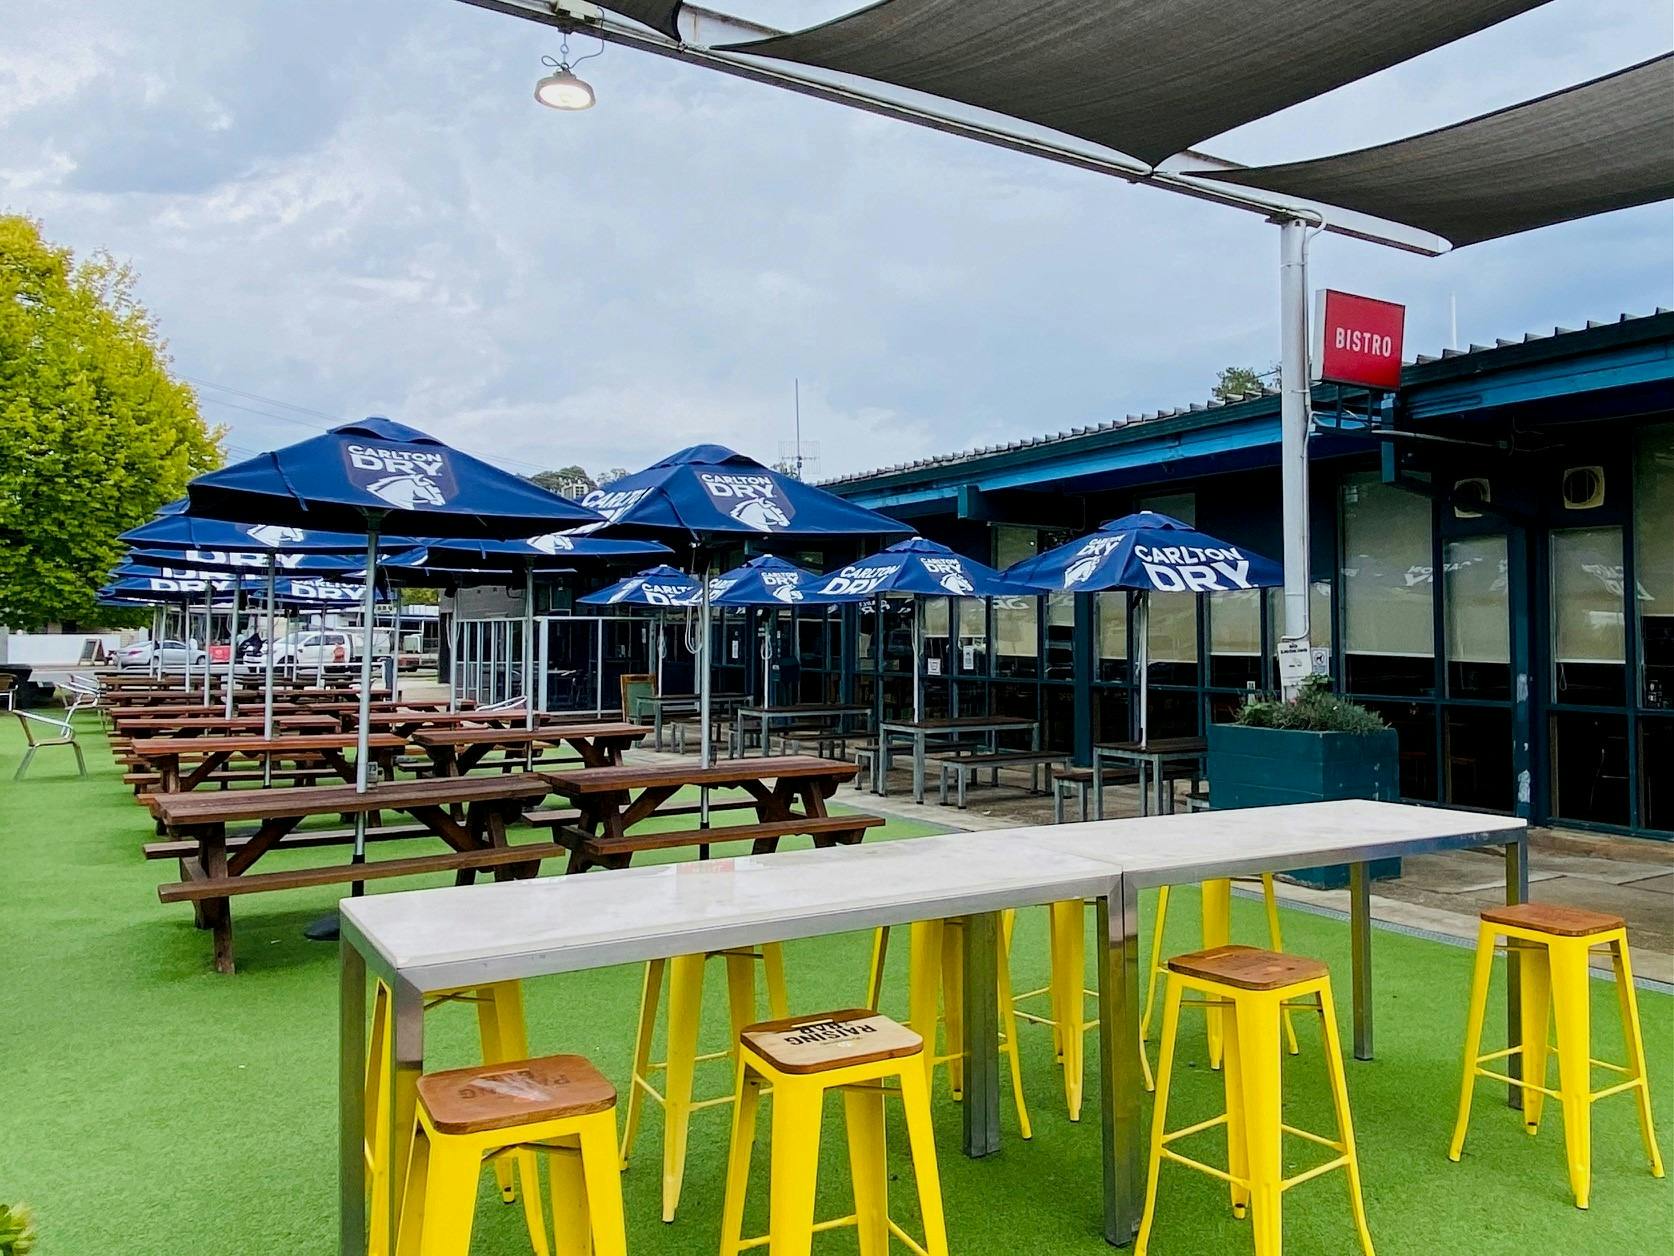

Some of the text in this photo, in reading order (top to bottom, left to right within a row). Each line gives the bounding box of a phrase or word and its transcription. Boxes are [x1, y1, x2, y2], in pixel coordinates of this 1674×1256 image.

[1335, 327, 1391, 358] BISTRO
[347, 445, 442, 462] CARLTON
[350, 453, 443, 477] DRY
[701, 473, 770, 485] CARLTON
[705, 482, 775, 498] DRY
[1076, 540, 1120, 556] DRY
[1134, 545, 1244, 565] CARLTON
[840, 564, 900, 579] CARLTON
[924, 562, 962, 574] DRY
[1142, 560, 1255, 592] DRY
[149, 577, 231, 592] DRY
[641, 582, 695, 595] CARLT
[763, 577, 799, 585] DRY
[816, 576, 889, 595] DRY
[291, 582, 367, 600] DRY
[784, 1024, 878, 1046] RAISING
